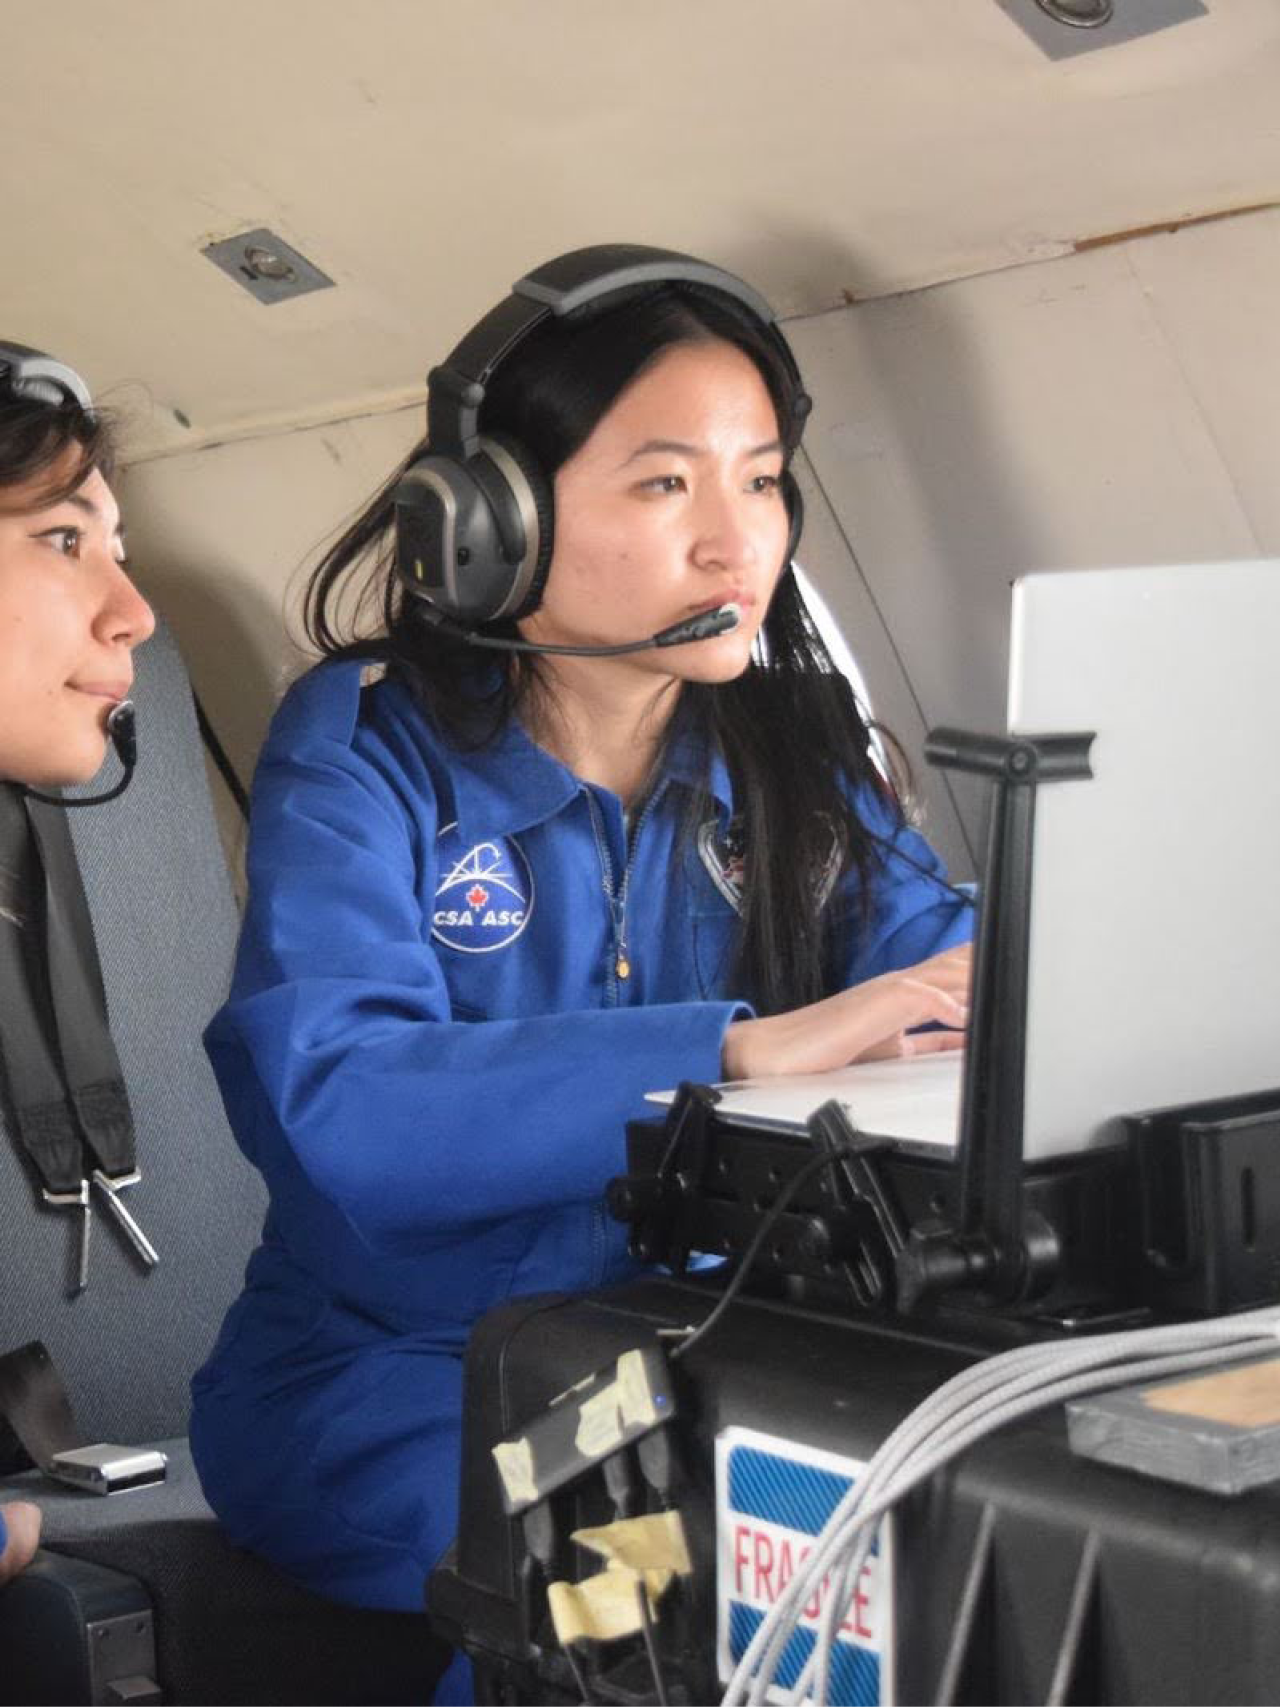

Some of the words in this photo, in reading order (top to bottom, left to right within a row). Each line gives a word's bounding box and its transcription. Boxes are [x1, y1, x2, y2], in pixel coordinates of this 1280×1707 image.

[434, 911, 473, 926] CSA
[482, 910, 524, 926] ASC
[735, 1523, 872, 1639] FRAE
